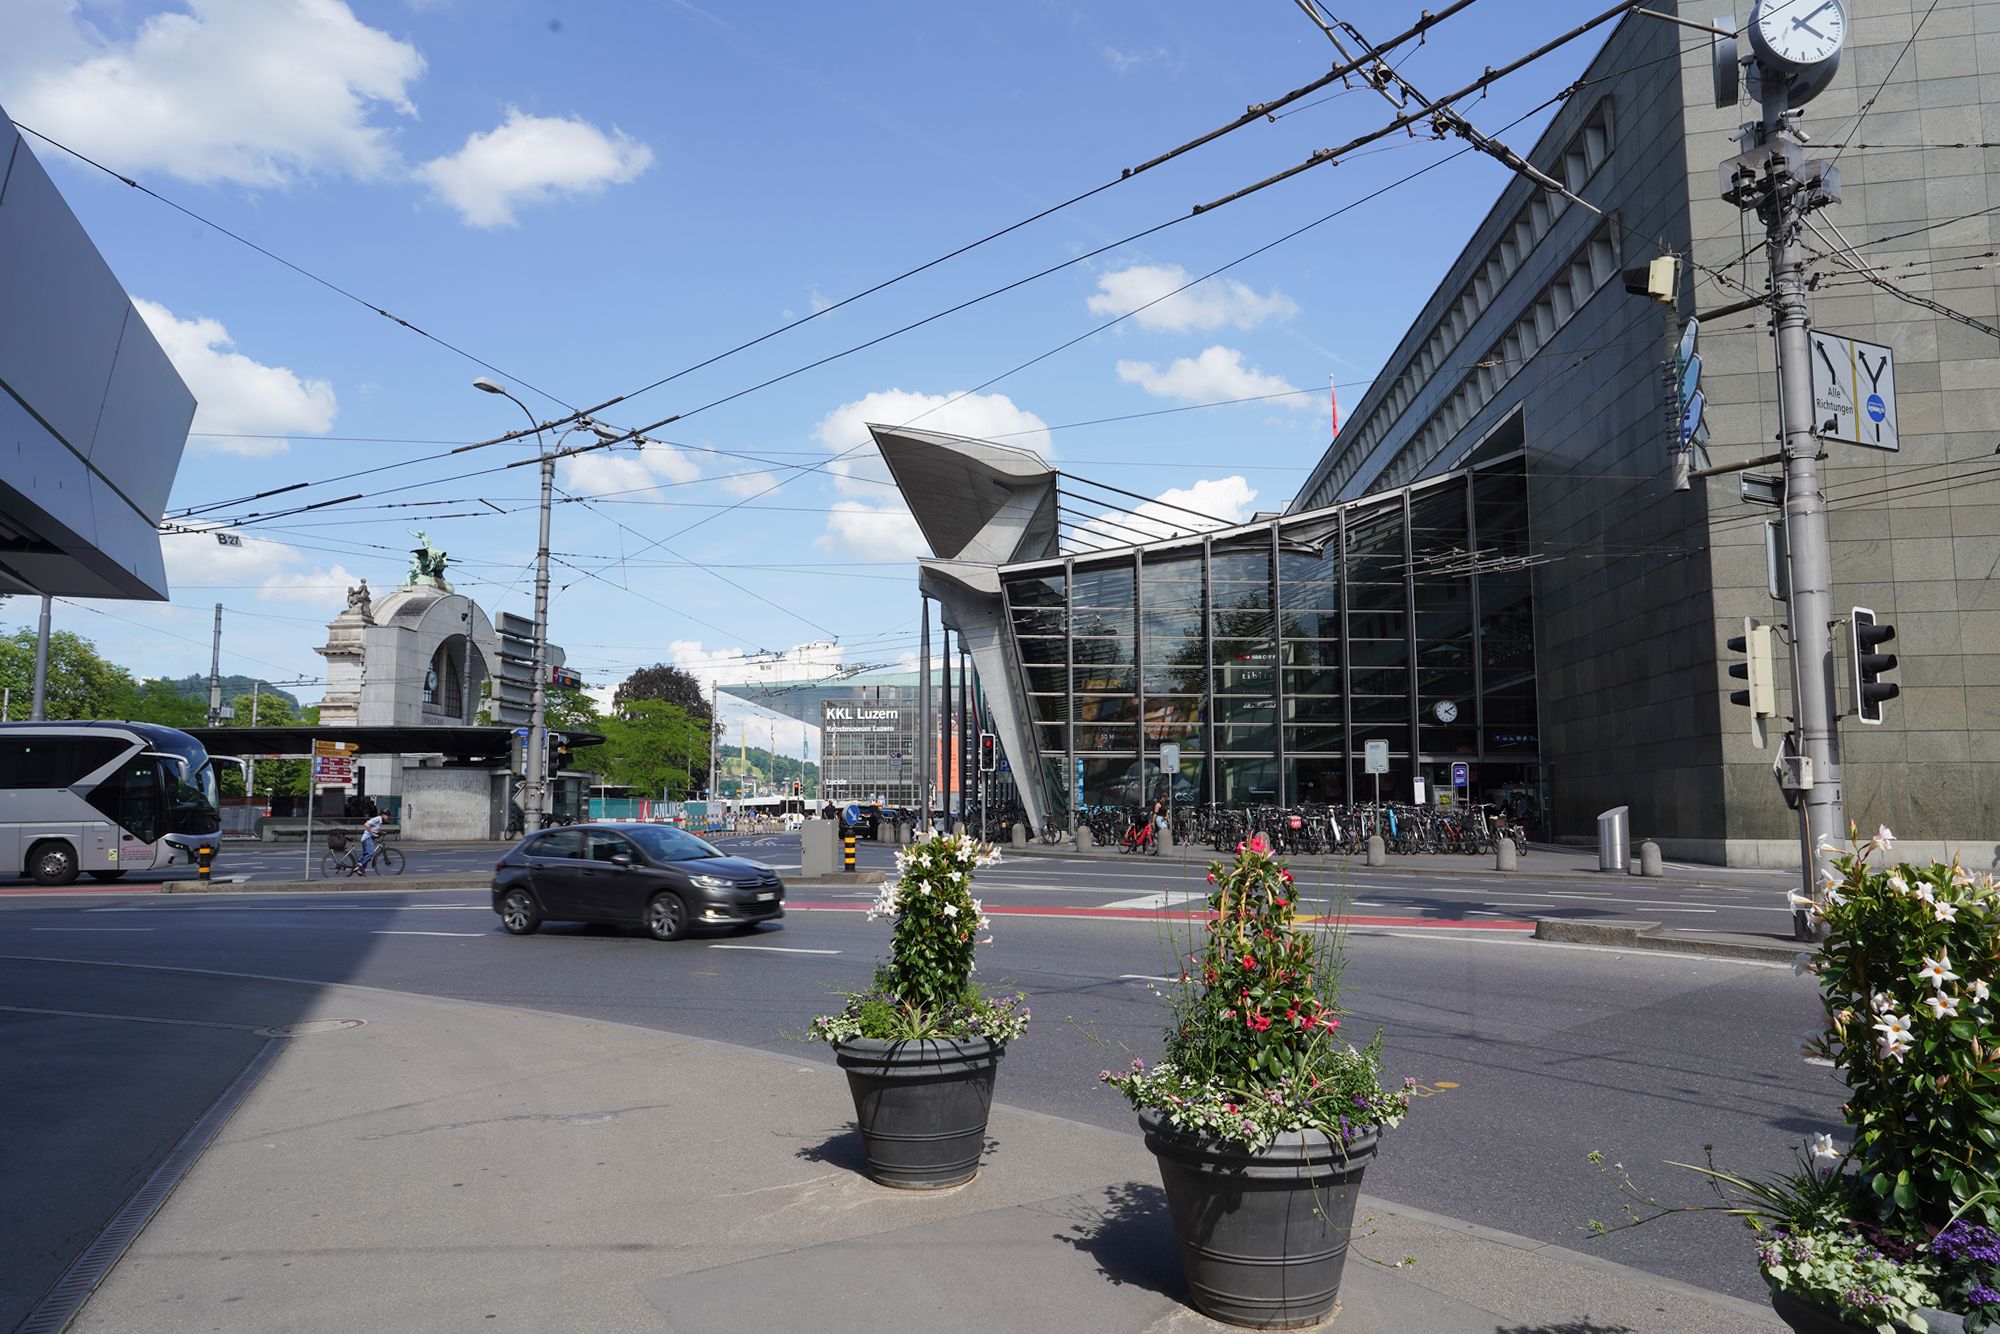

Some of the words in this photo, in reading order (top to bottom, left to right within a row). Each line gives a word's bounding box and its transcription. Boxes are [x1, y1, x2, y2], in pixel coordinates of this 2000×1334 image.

[1828, 387, 1841, 398] Alle
[1816, 398, 1854, 416] Richtungen
[826, 707, 853, 720] KKL
[857, 707, 898, 720] Luzern
[1000, 760, 1008, 770] P
